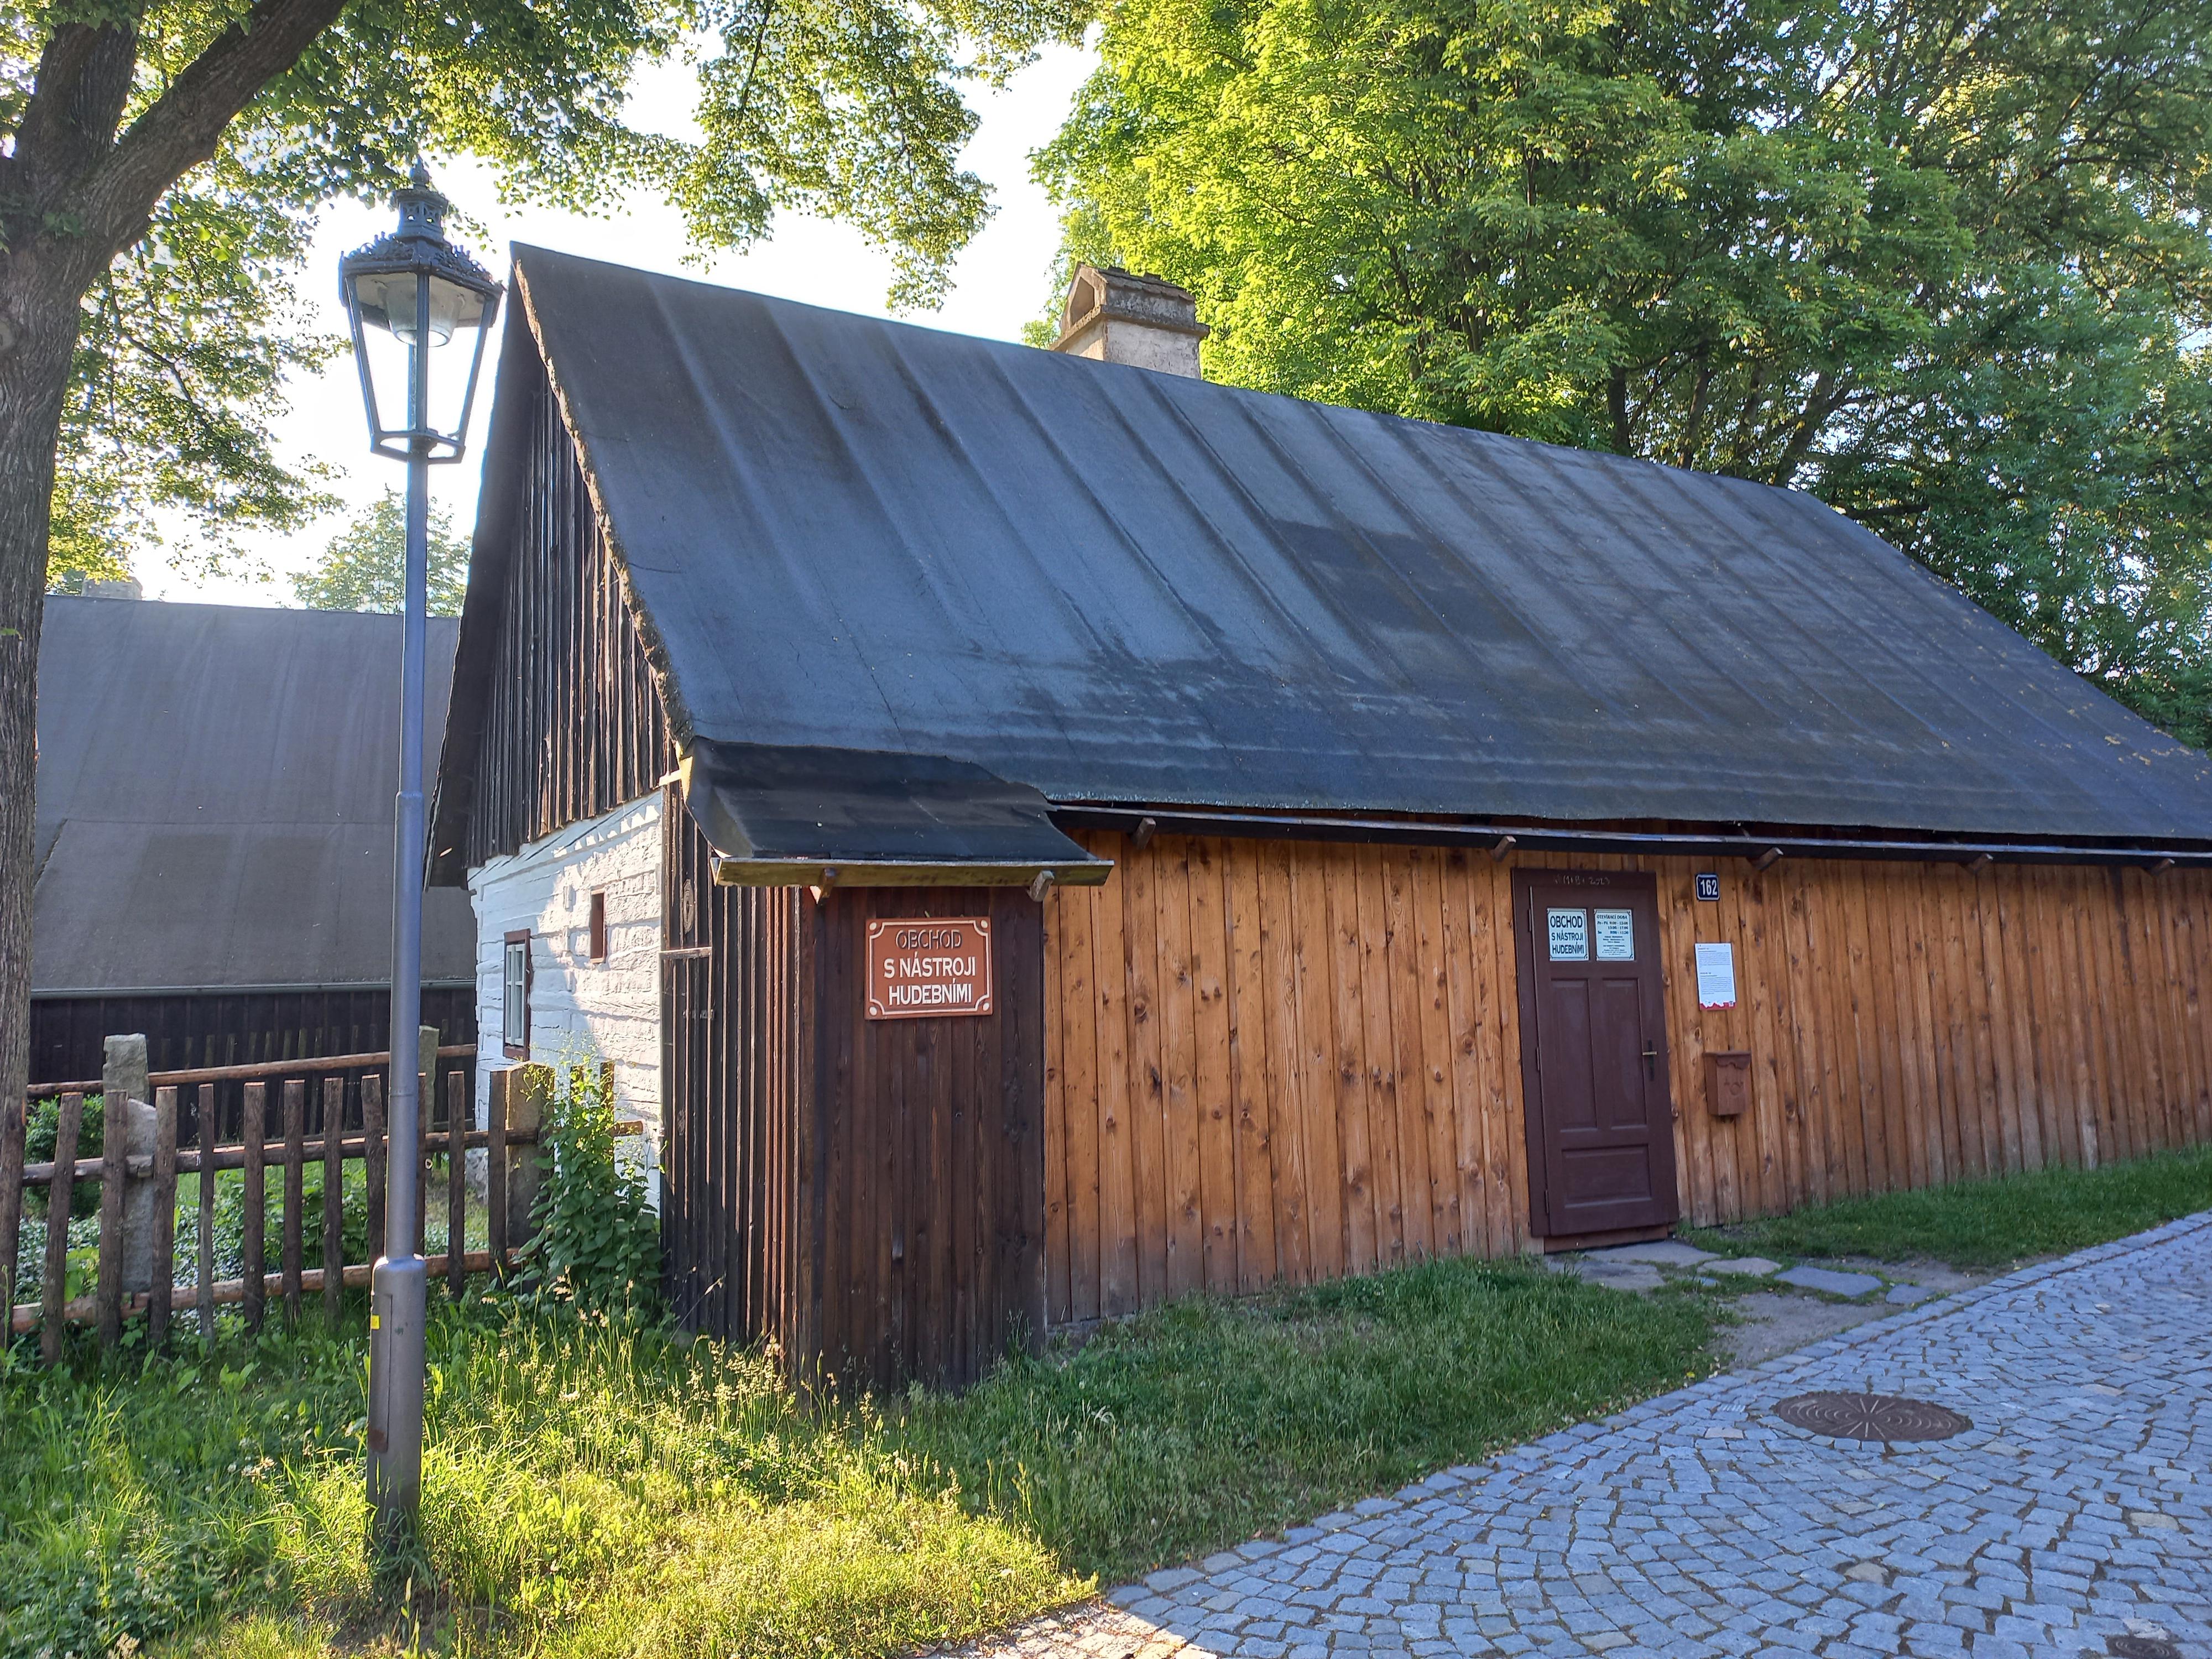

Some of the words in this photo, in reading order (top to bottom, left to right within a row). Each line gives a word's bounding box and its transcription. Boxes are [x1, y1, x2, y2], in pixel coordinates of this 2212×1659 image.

[1700, 879, 1718, 895] 162
[1550, 915, 1583, 928] OBCHOD
[895, 929, 962, 950] OBCHOD
[1551, 932, 1556, 941] S
[1557, 930, 1583, 941] NÁSTROJI
[1552, 941, 1584, 954] HUDEBNÍMI
[884, 958, 895, 979] S
[899, 951, 976, 978] NÁSTROJI
[888, 978, 972, 1005] HUDEBNÍMI
